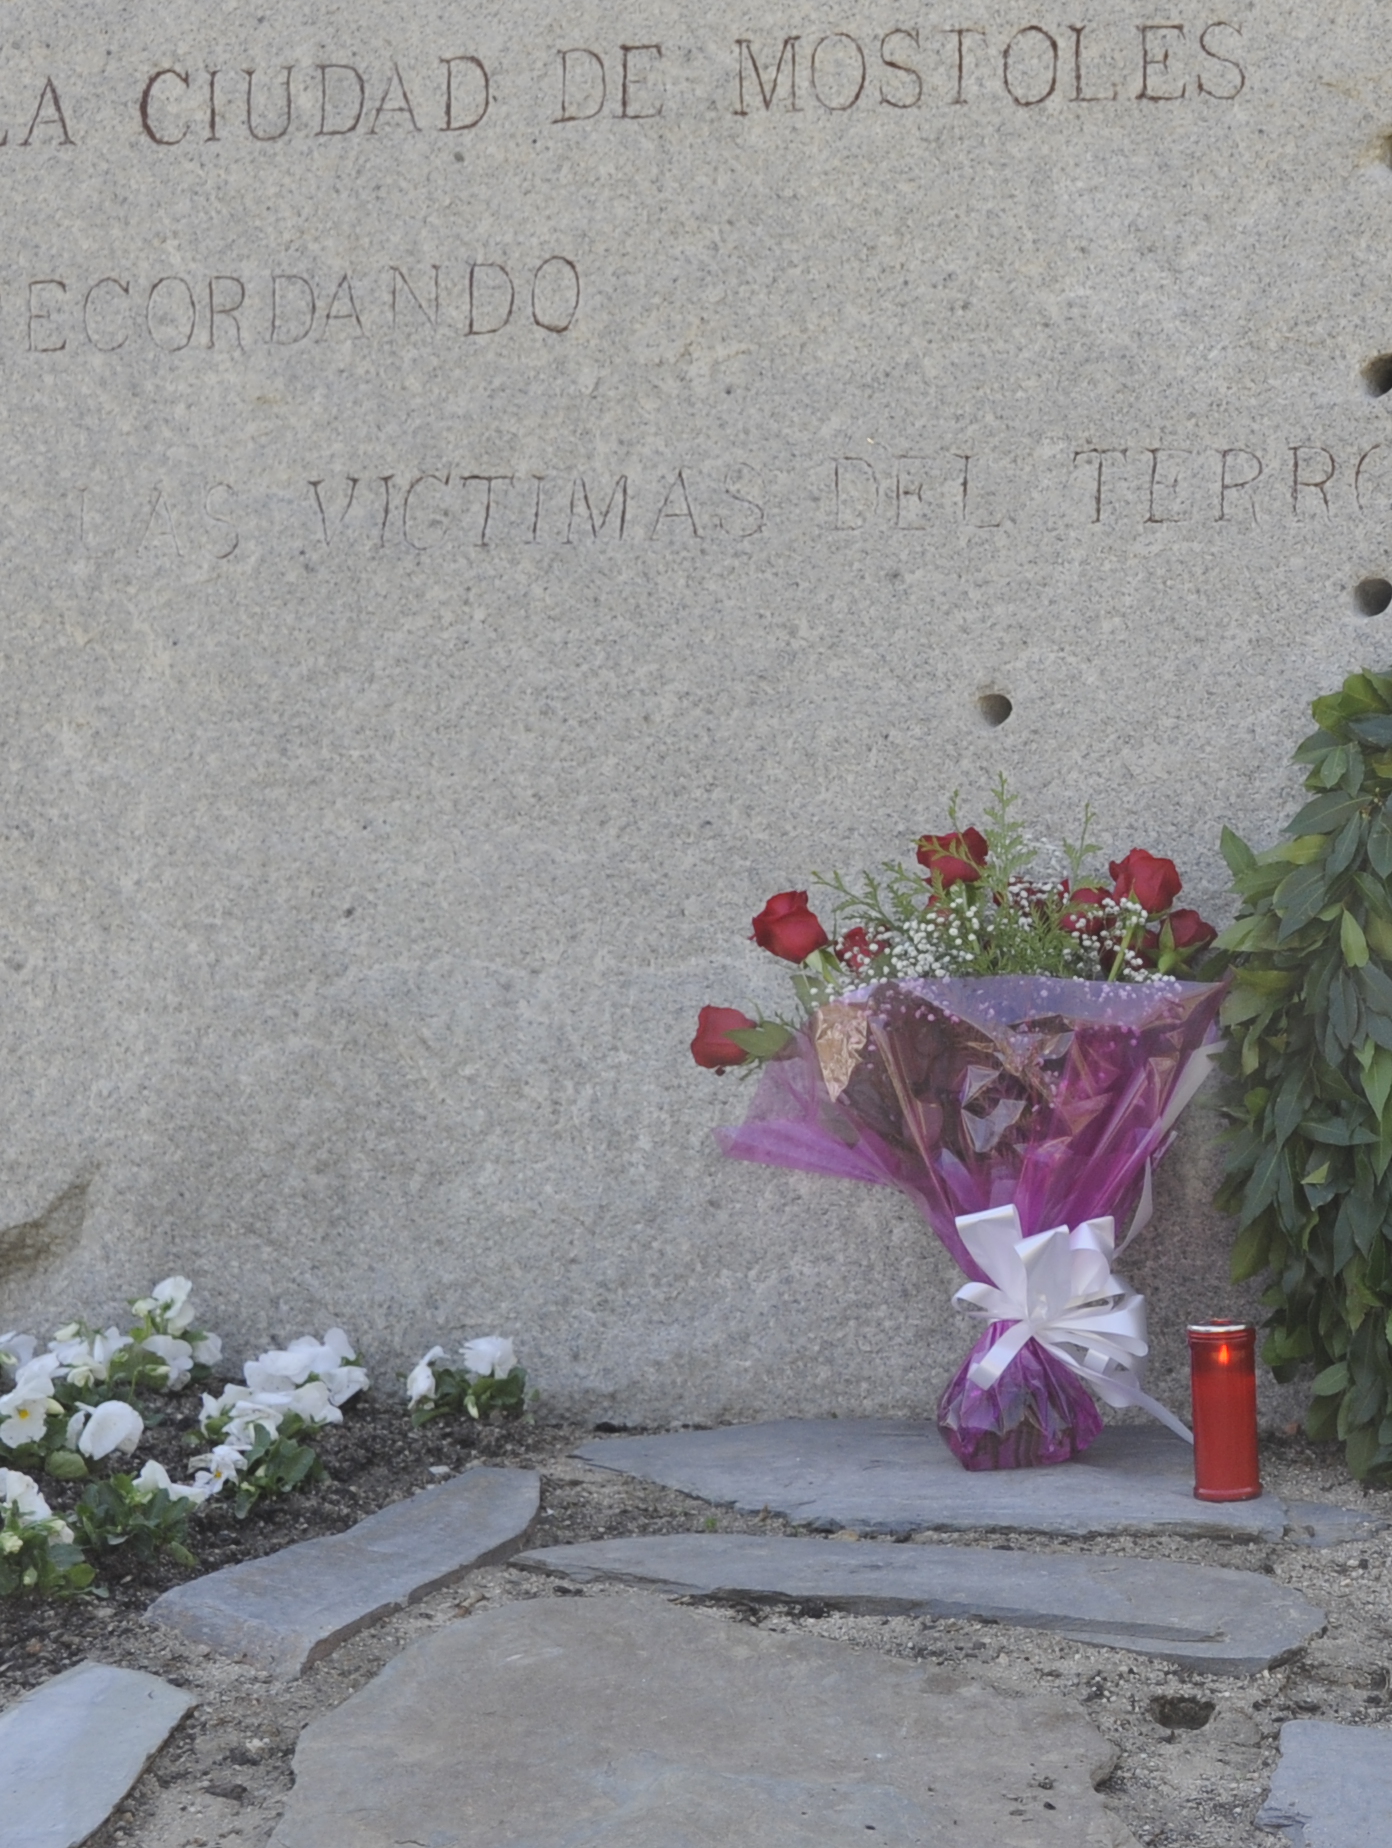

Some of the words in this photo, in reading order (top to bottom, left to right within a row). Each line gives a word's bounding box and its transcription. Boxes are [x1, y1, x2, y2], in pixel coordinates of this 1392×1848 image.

[0, 75, 77, 147] A
[139, 56, 492, 146] CIUDAD
[552, 44, 664, 124] DE
[731, 20, 1246, 117] MOSTOLES
[26, 255, 580, 353] ECORDANDO
[72, 478, 240, 560] LAS
[307, 462, 767, 551] VICTIMAS
[830, 452, 1001, 531] DEL
